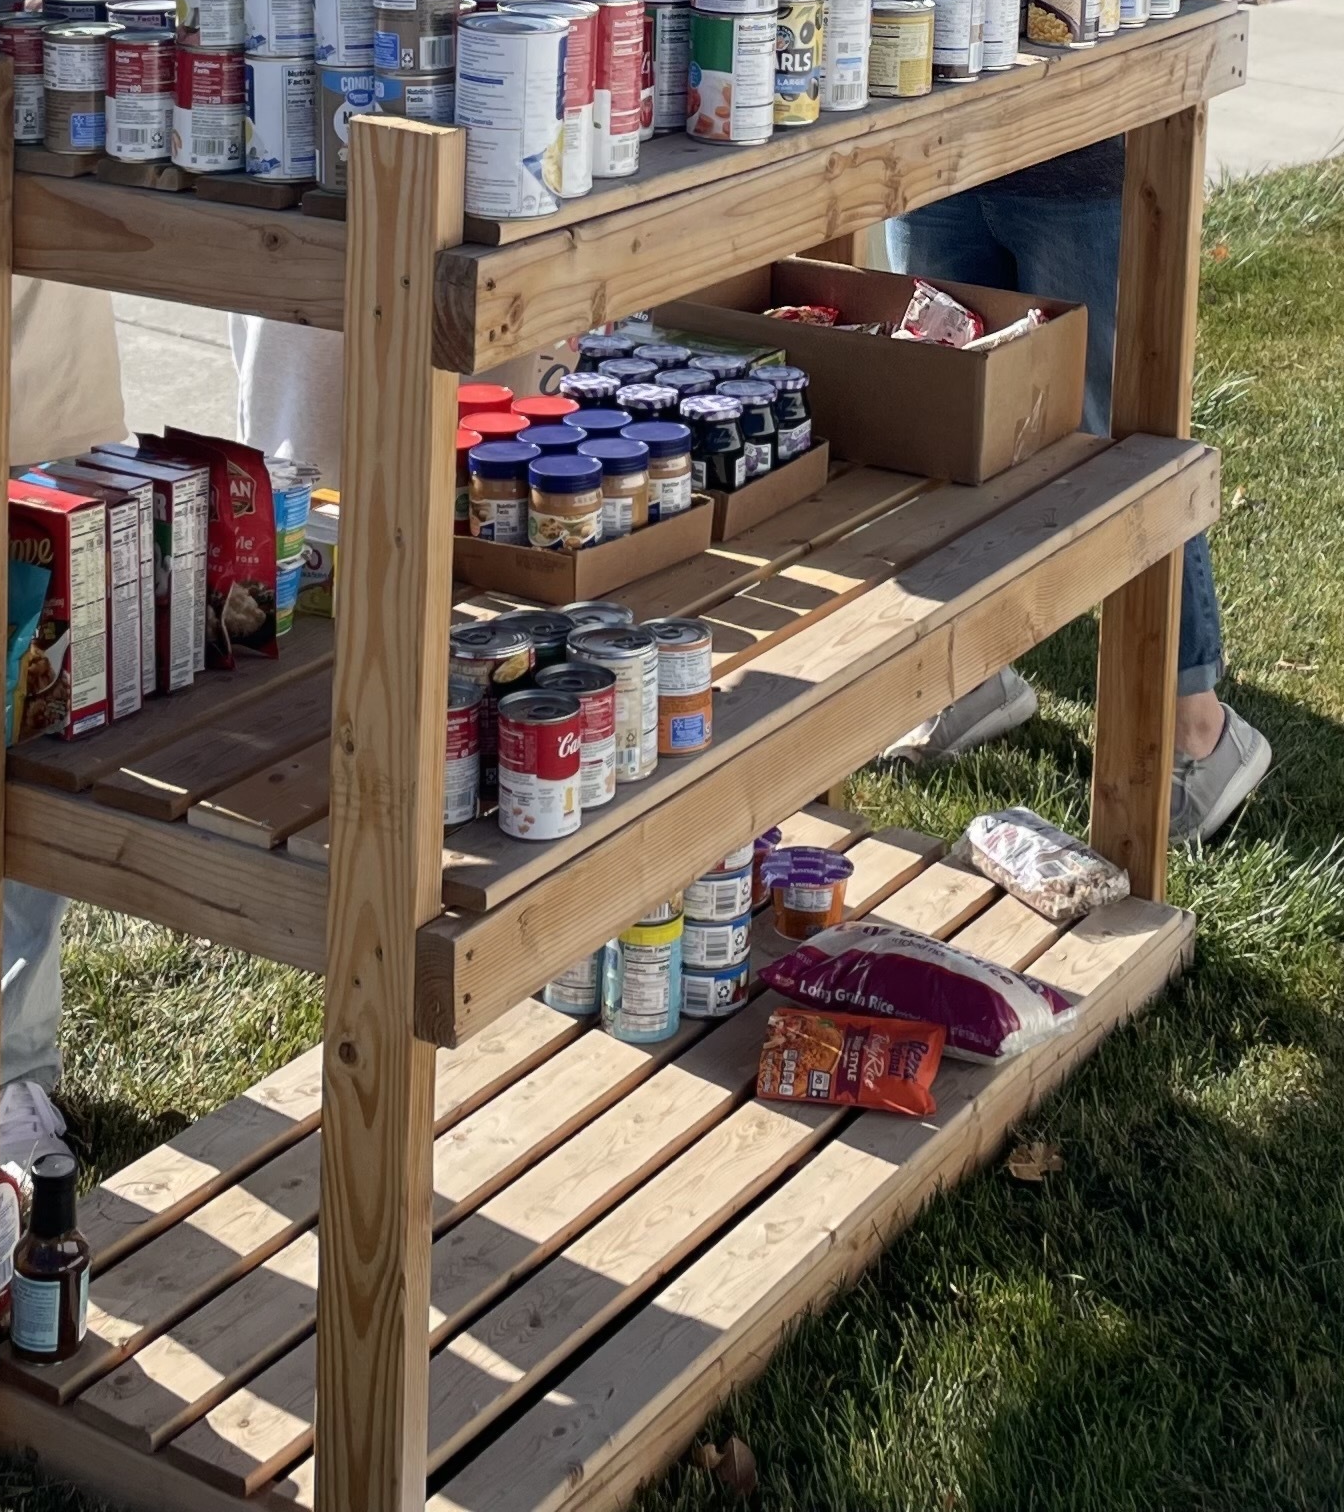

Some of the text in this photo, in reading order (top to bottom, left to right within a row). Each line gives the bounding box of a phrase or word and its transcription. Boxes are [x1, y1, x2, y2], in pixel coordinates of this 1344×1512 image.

[777, 78, 805, 86] LARGE
[799, 979, 832, 1004] Long
[868, 995, 895, 1015] Rice
[845, 1051, 858, 1082] STYLE
